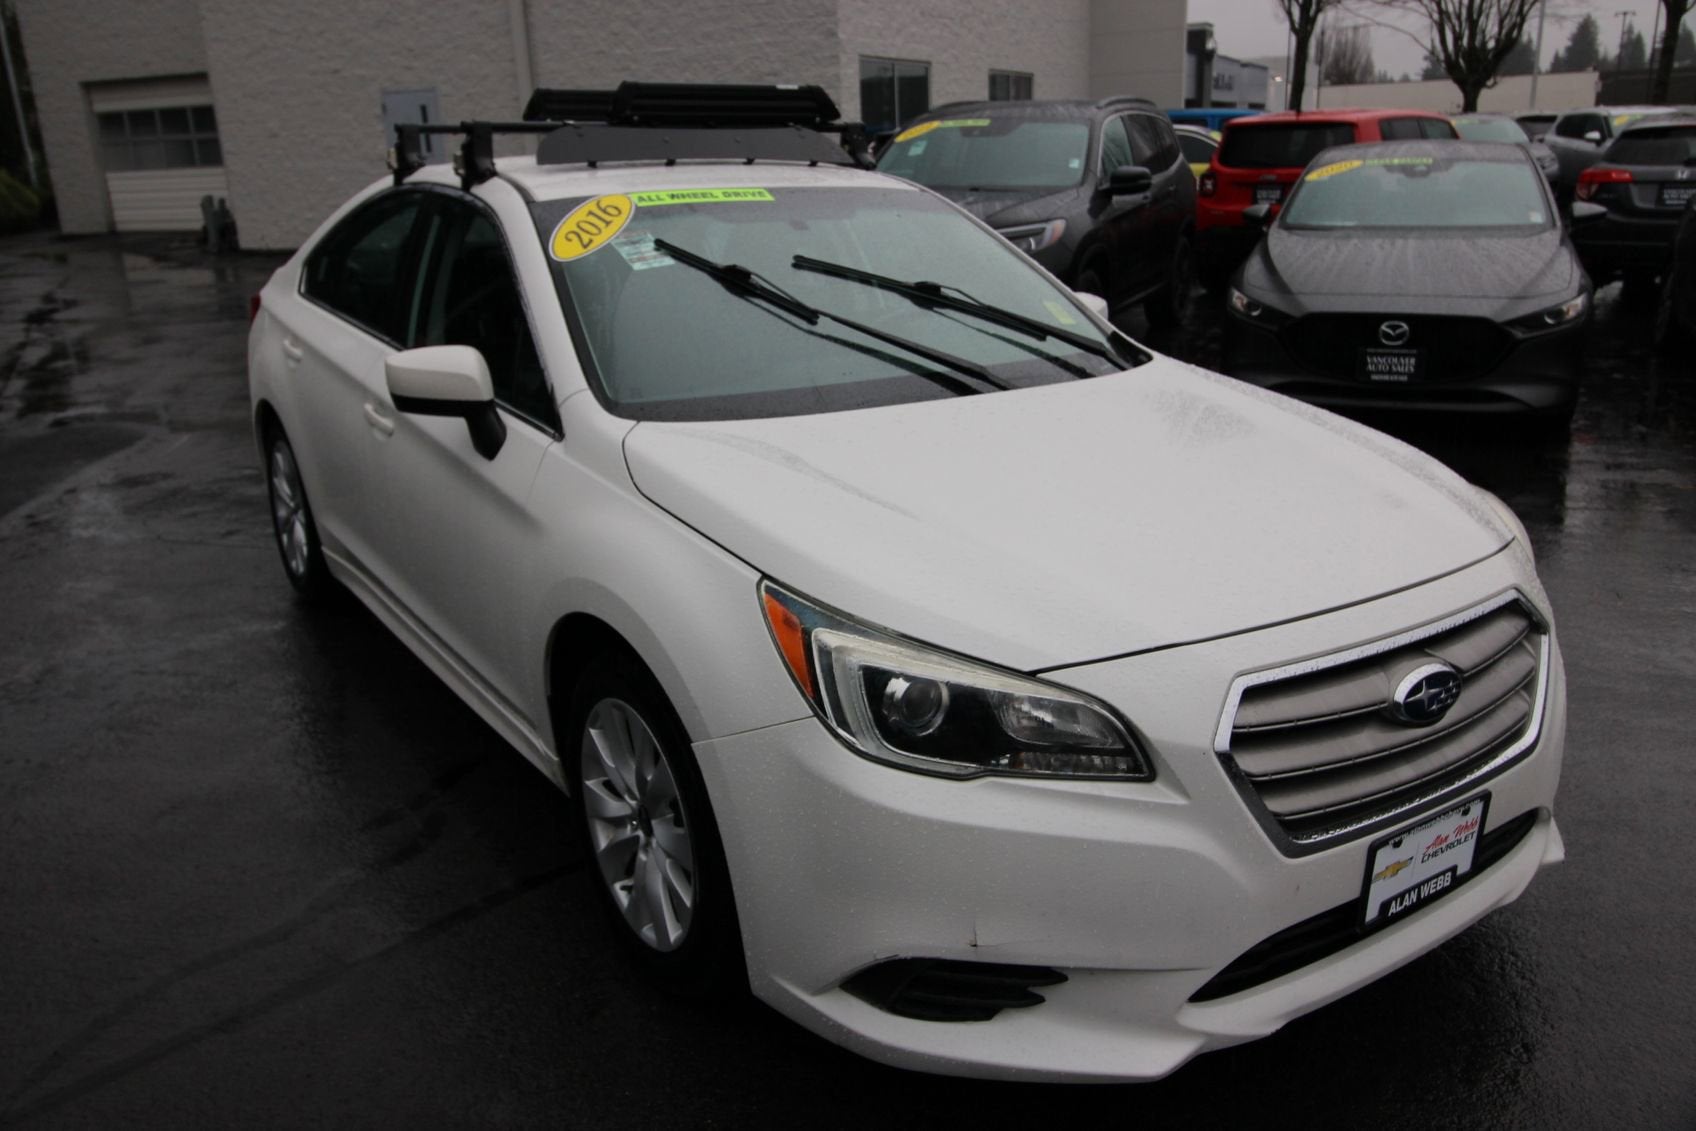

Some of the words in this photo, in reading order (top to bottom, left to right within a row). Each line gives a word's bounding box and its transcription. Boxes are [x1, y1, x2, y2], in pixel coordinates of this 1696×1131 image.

[636, 193, 665, 203] ALL
[667, 191, 719, 201] WHEEL
[723, 189, 768, 199] DRIVE
[565, 199, 622, 250] 2016
[1421, 831, 1476, 864] CHEVROLET
[1388, 888, 1417, 917] ALAN
[1420, 872, 1452, 899] WEBB
